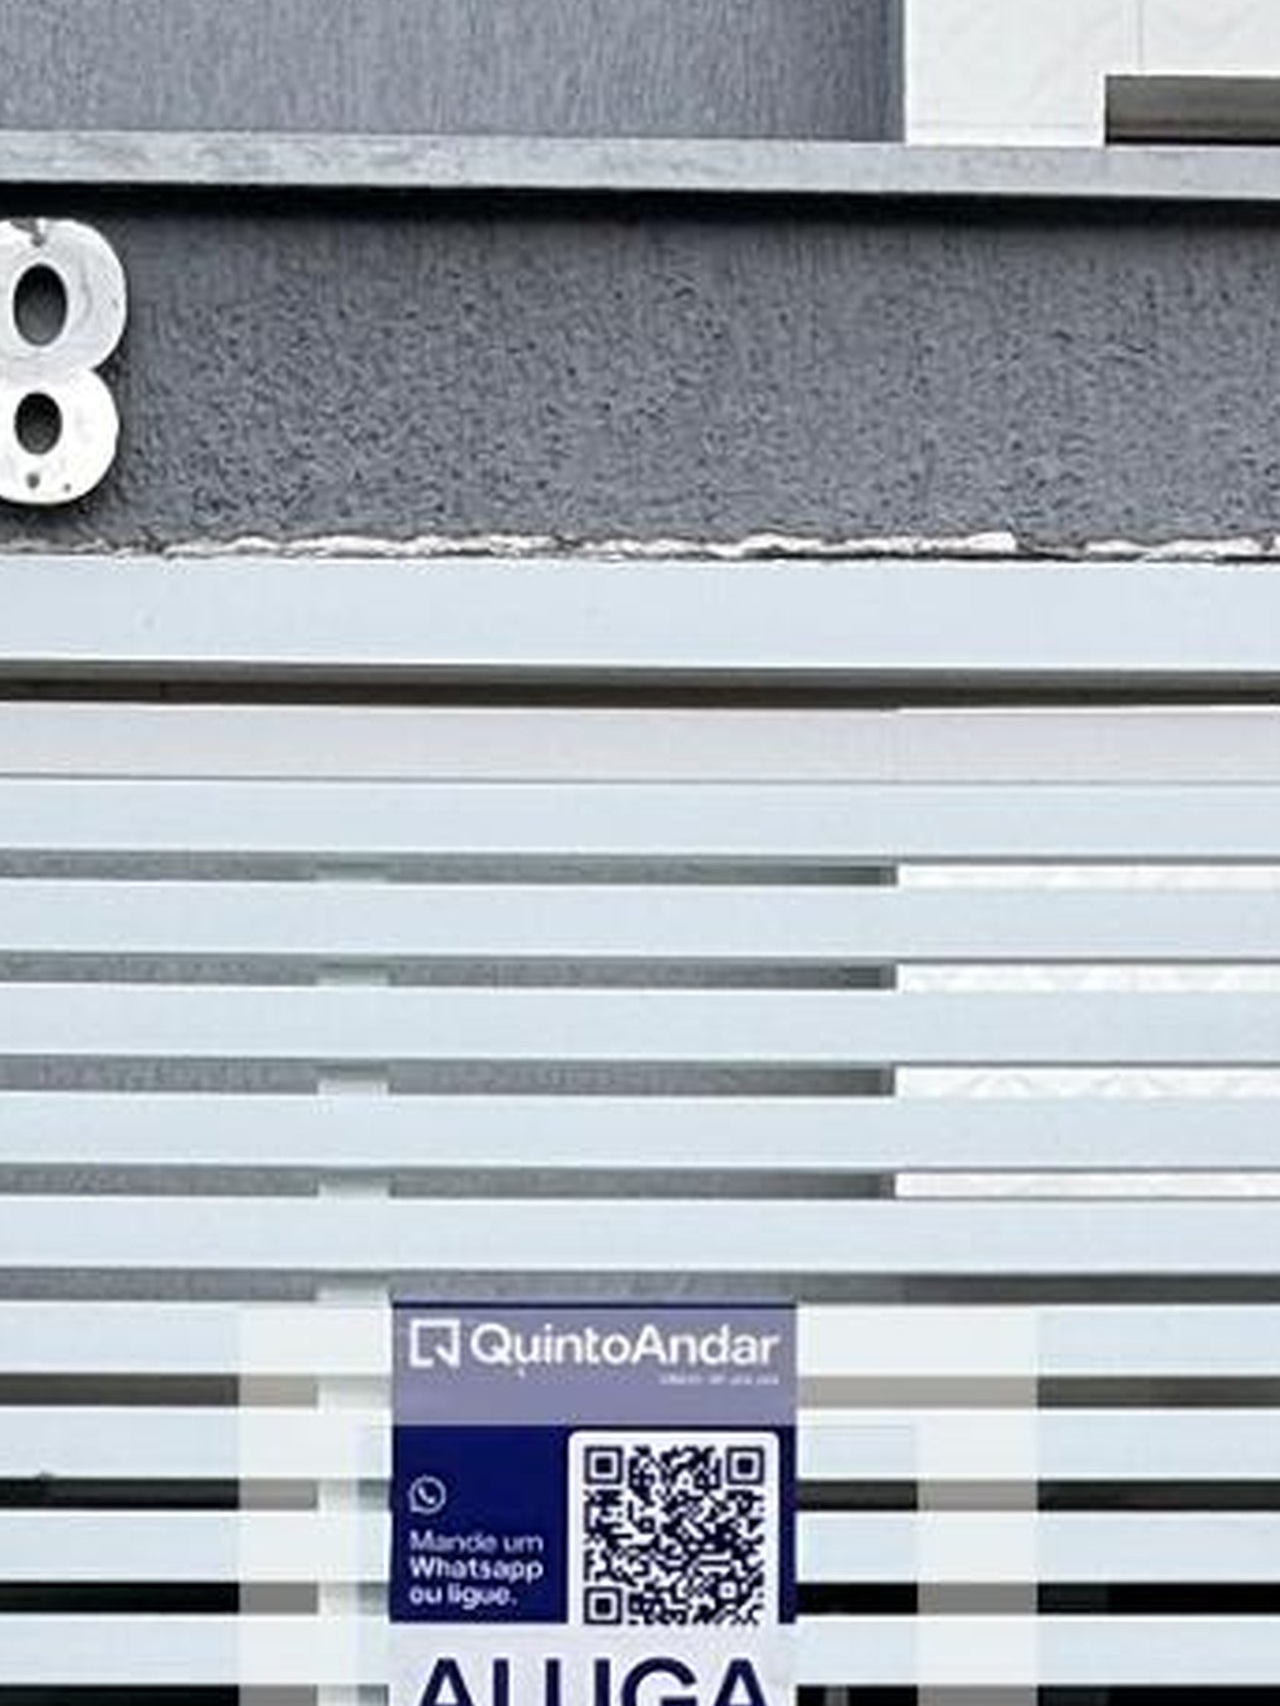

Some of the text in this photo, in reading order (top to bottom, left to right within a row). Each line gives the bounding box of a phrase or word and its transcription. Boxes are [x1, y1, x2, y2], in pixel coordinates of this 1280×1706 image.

[469, 1322, 780, 1368] QuintoAndar
[408, 1530, 545, 1554] Mande um
[408, 1556, 545, 1585] Whatsapp
[408, 1582, 518, 1611] ou ligue.
